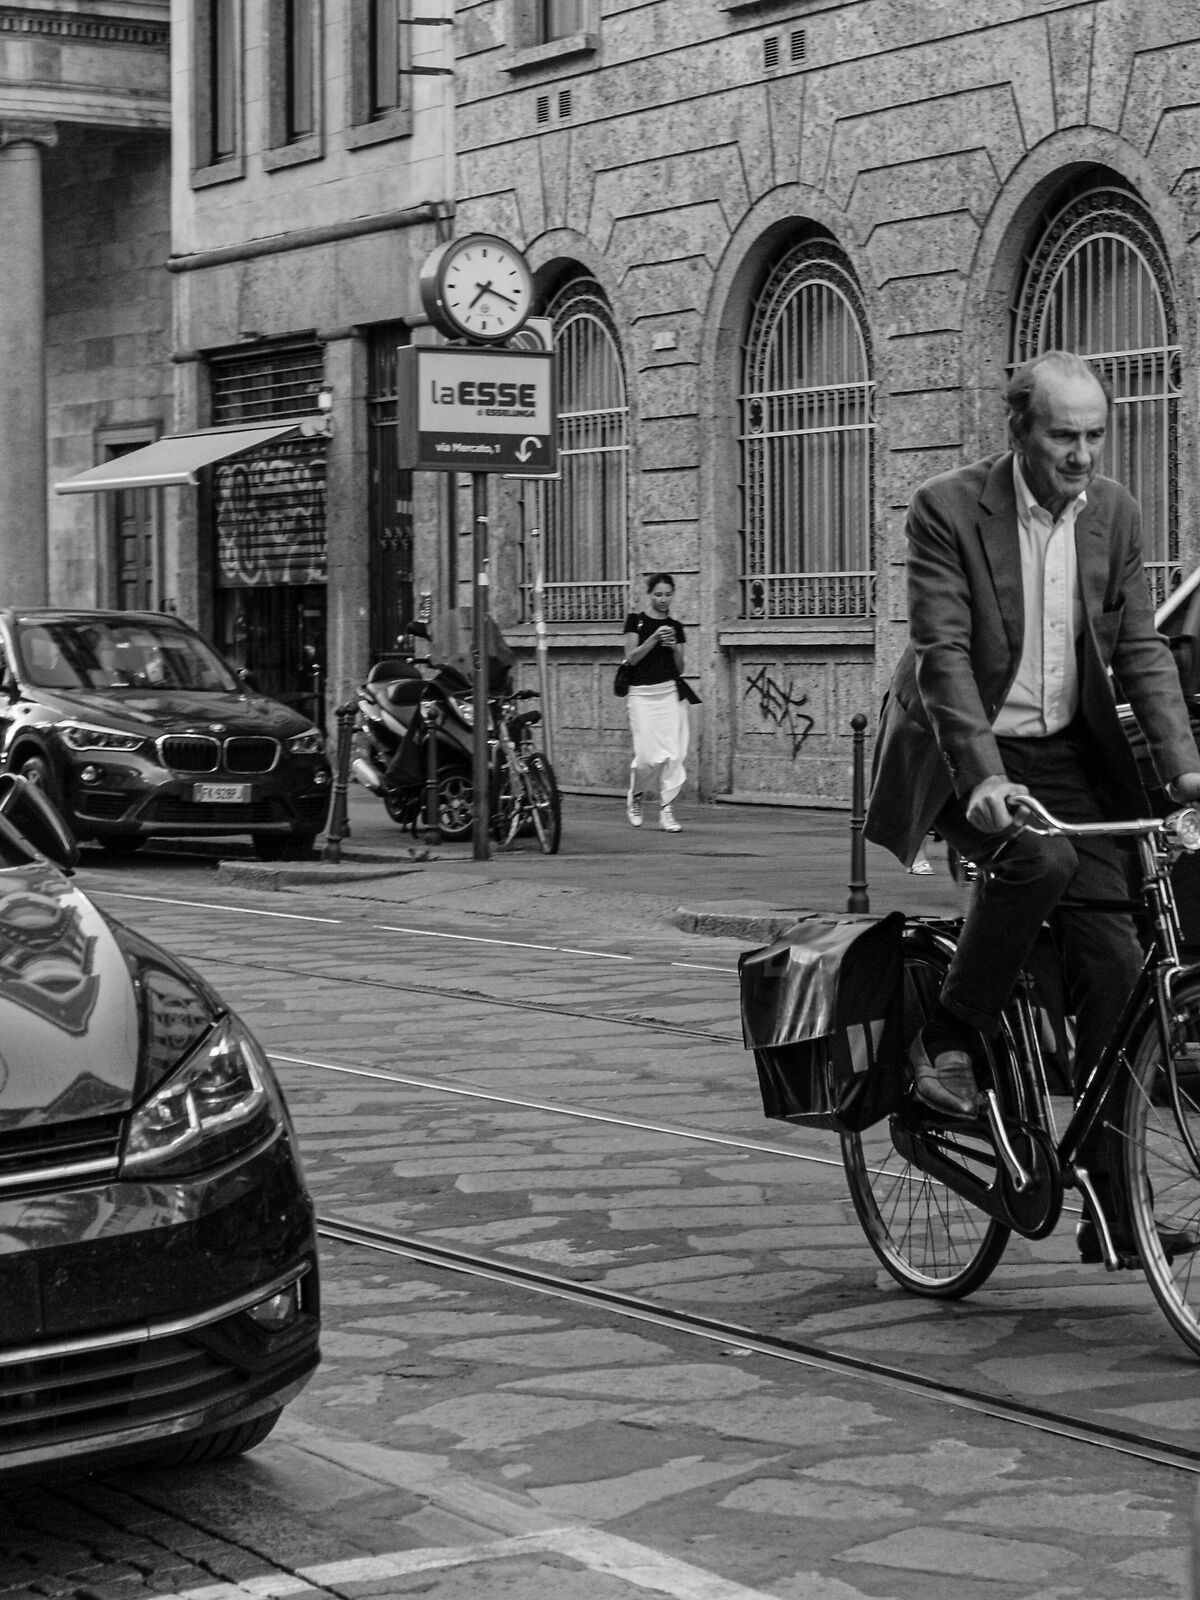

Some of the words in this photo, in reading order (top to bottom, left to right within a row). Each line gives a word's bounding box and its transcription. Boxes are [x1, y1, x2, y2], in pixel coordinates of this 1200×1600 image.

[431, 380, 537, 408] laESSE
[485, 408, 536, 417] ESSELUNGA
[435, 442, 451, 452] via
